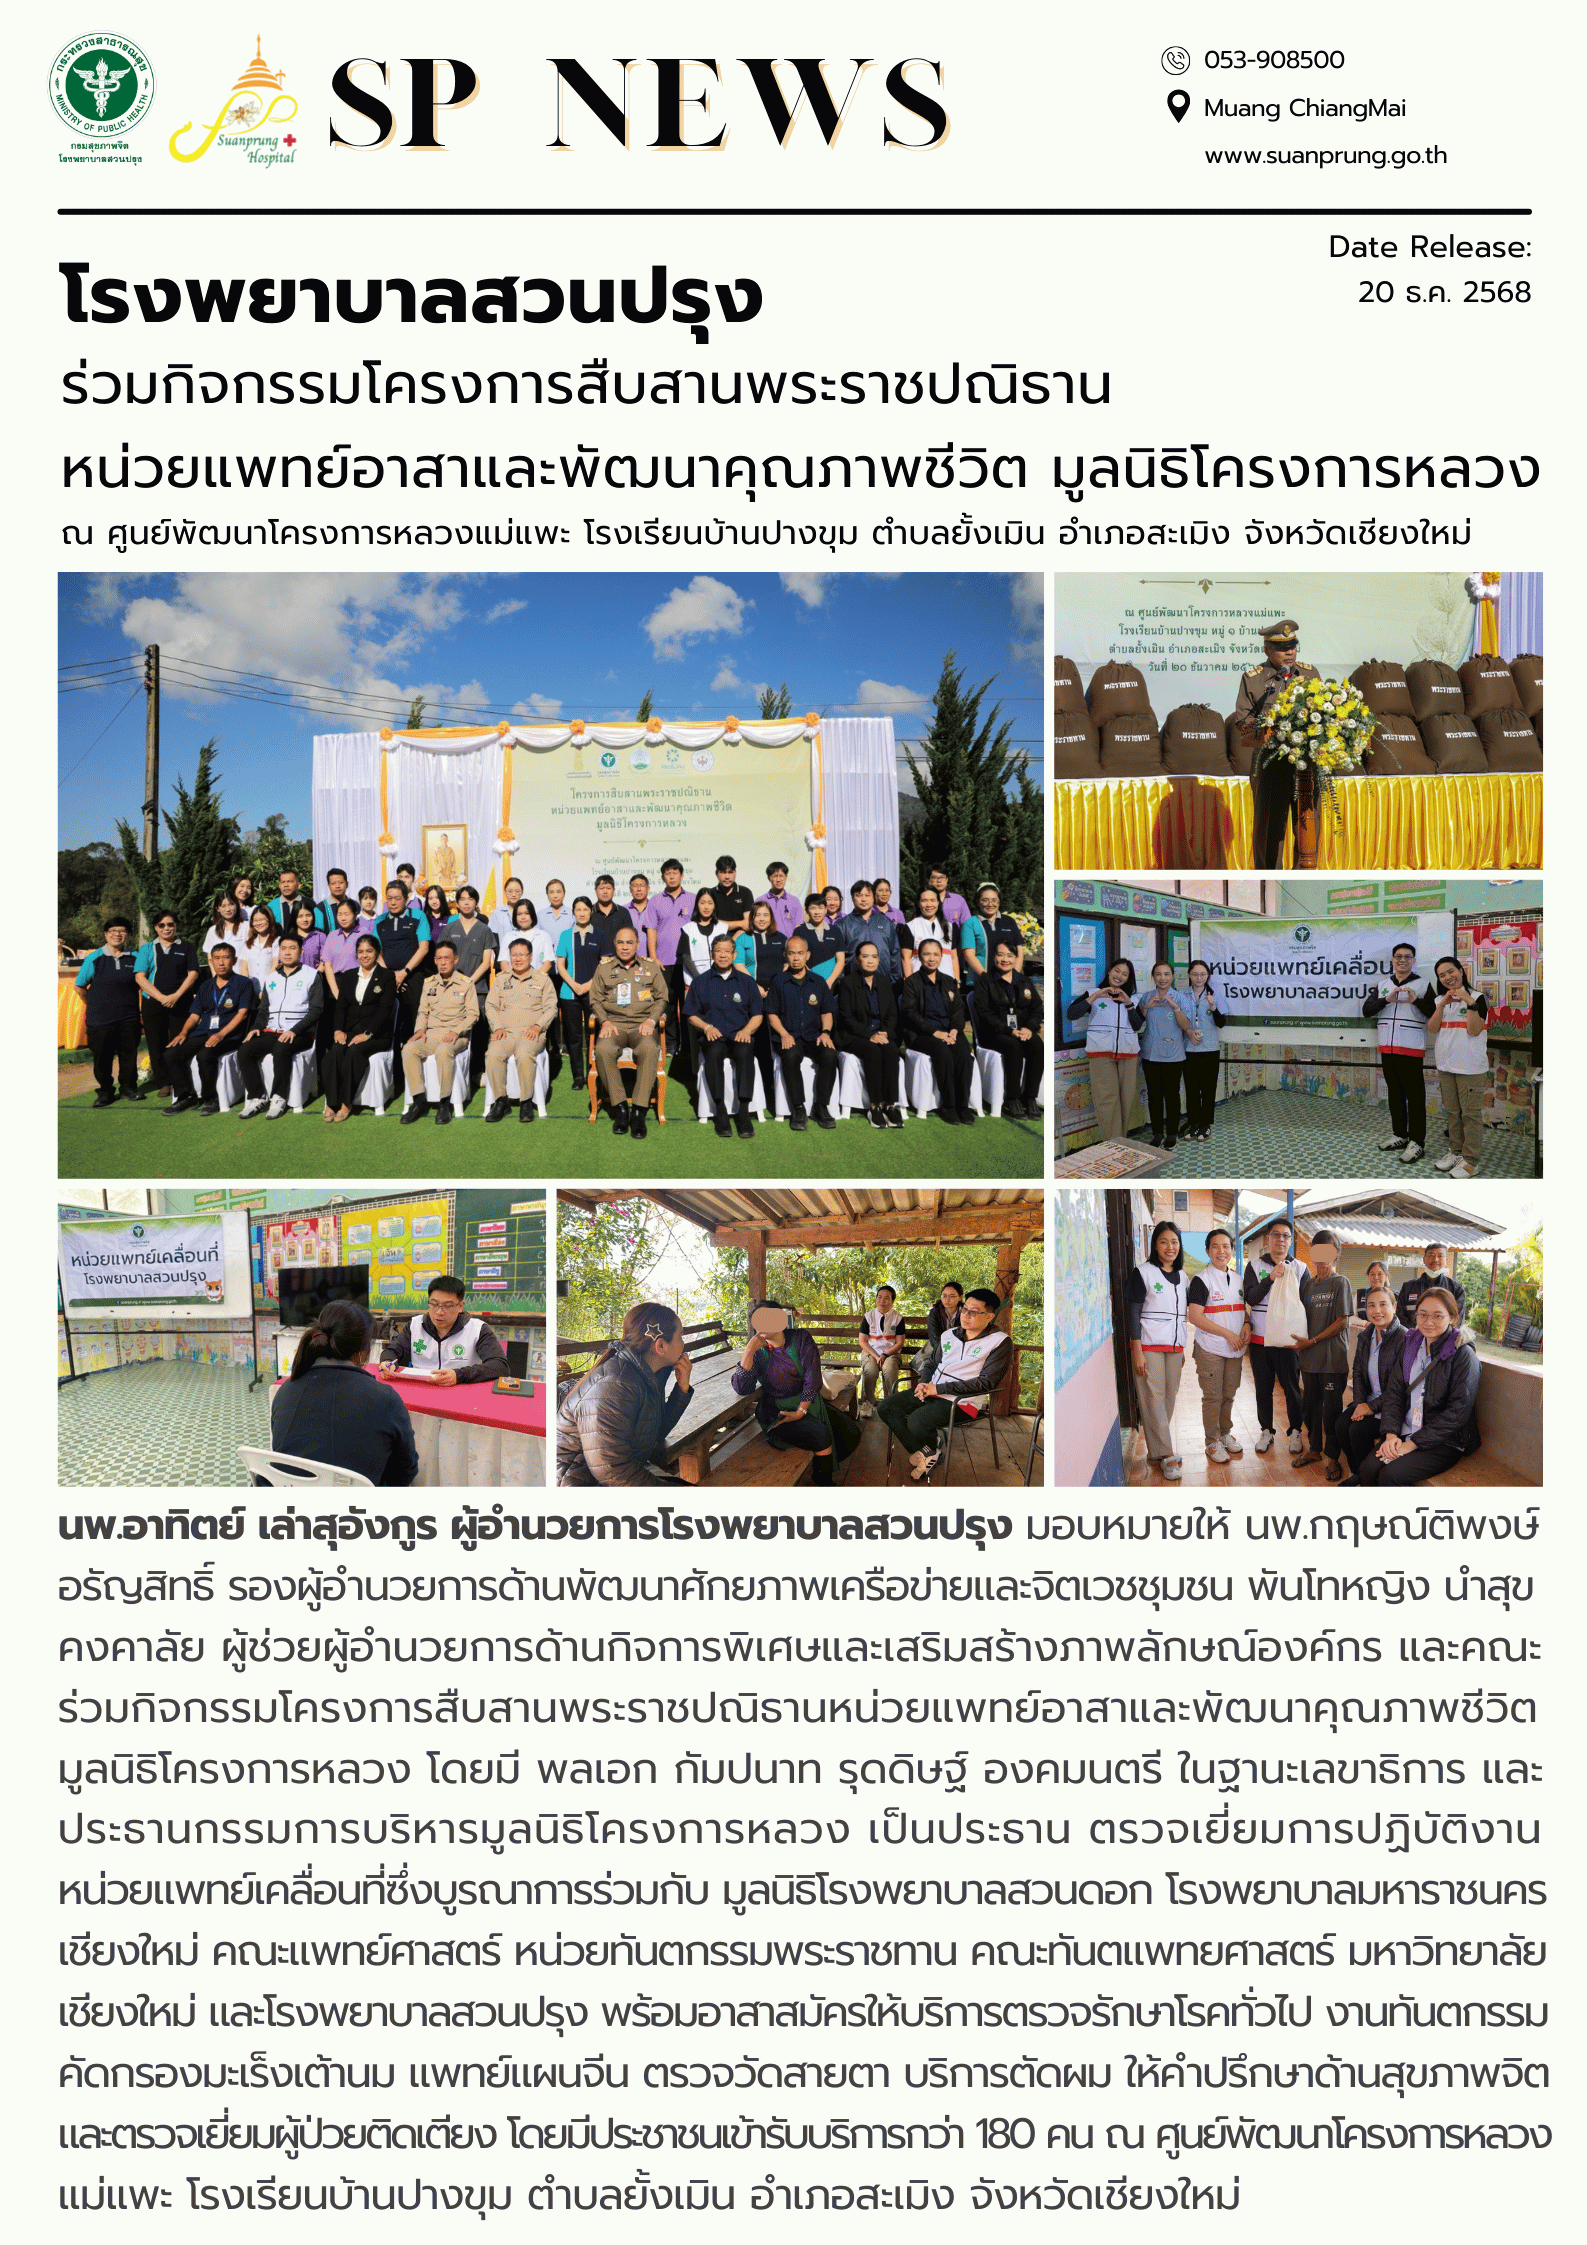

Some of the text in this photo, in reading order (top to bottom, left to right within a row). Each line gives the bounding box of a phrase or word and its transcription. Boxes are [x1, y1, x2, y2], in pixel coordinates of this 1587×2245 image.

[1125, 605, 1286, 620] ณ ศูนย์พัฒนาโครงการหลวงแม่แพะ
[1119, 623, 1208, 639] โรงเรียนบ้านปางขุม
[1212, 625, 1225, 639] หมู่
[1109, 640, 1165, 654] ตำบลยั้งเมิน
[1168, 642, 1226, 654] อำเภอสะเมิง
[1148, 658, 1168, 672] วันที่
[1191, 661, 1228, 672] ธันวาคม
[1210, 951, 1394, 976] หน่วยแพทย์เคลื่อน
[71, 1241, 219, 1268] หน่วยแพทย์เคลื่อนที่
[84, 1269, 207, 1286] โรงพยาบาลสวนปรุง
